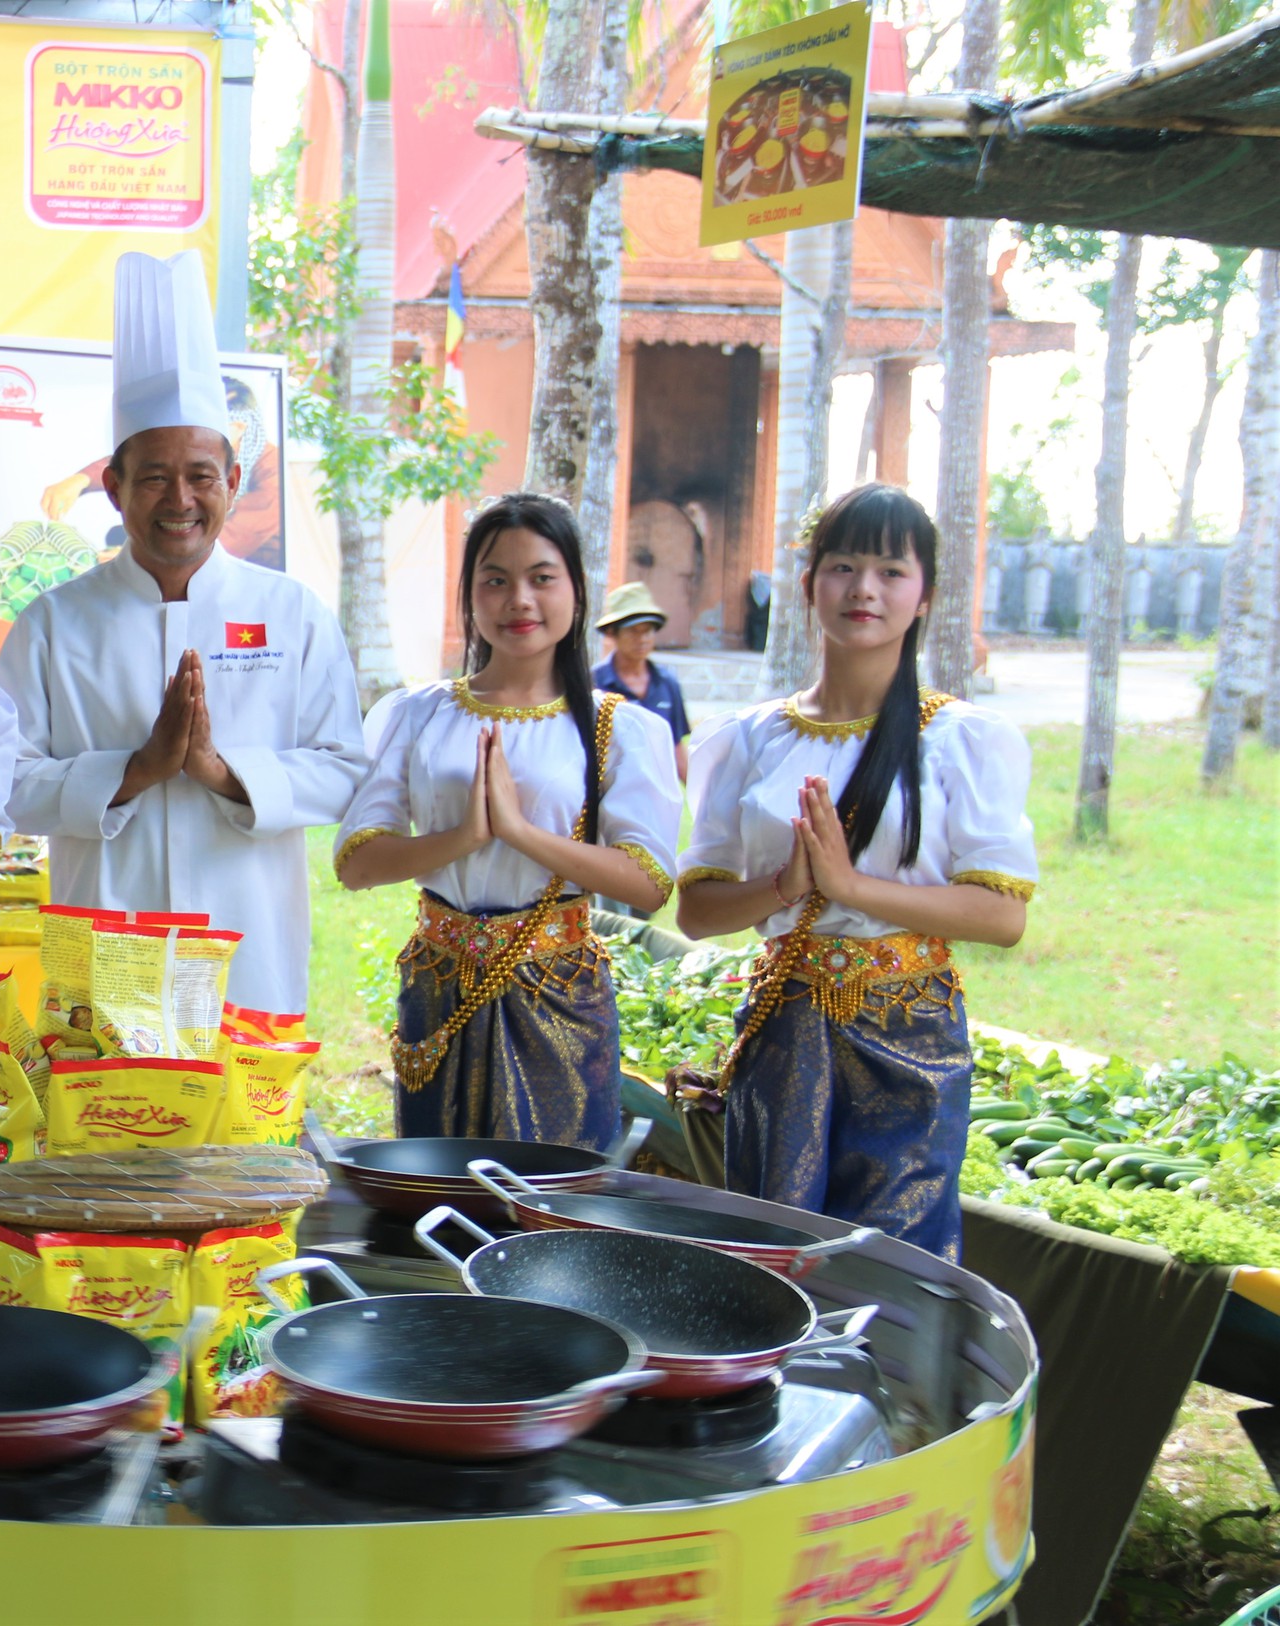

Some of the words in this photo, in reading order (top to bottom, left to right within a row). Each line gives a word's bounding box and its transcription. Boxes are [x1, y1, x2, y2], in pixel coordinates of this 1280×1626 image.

[55, 61, 88, 77] BỘT
[96, 64, 142, 79] TRỘN
[53, 82, 183, 110] MIKKO
